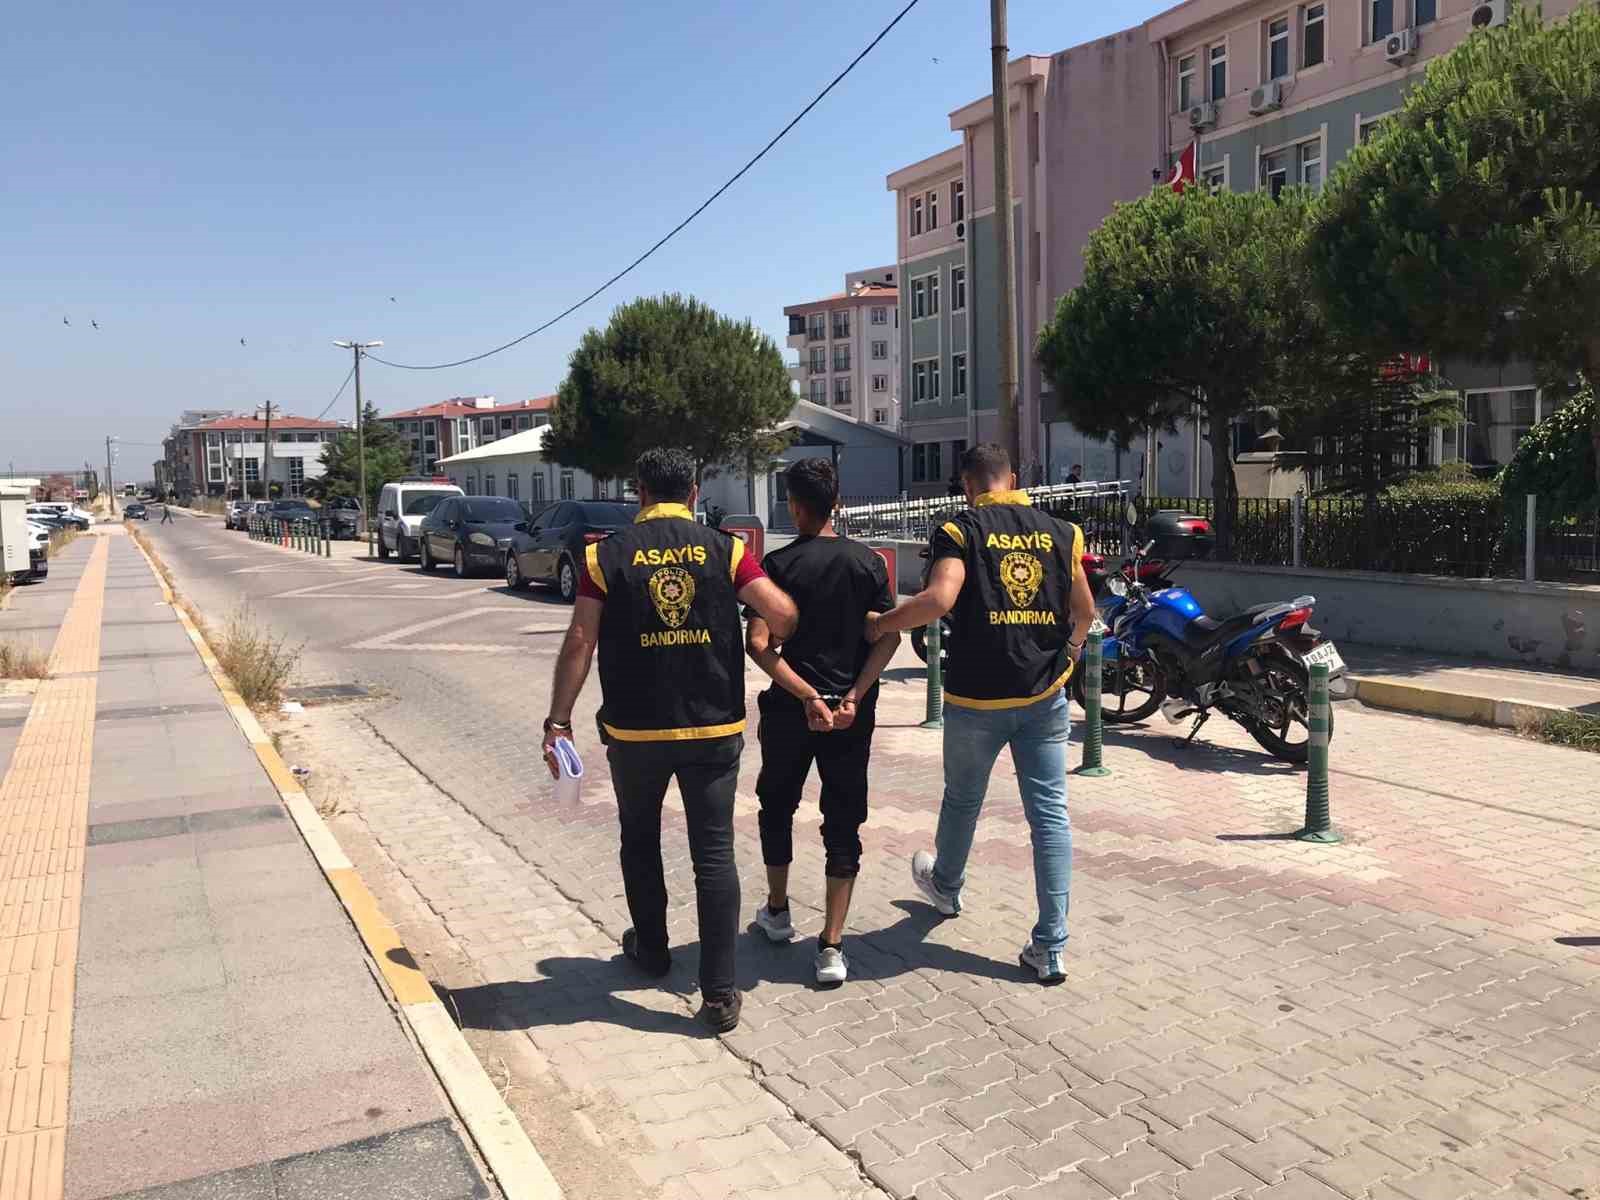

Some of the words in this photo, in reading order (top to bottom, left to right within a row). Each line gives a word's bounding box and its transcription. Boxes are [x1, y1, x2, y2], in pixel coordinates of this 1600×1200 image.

[986, 531, 1053, 552] ASAYİŞ
[632, 544, 706, 565] ASAYİŞ
[989, 610, 1056, 625] BANDIRMA
[640, 629, 711, 647] BANDIRMA
